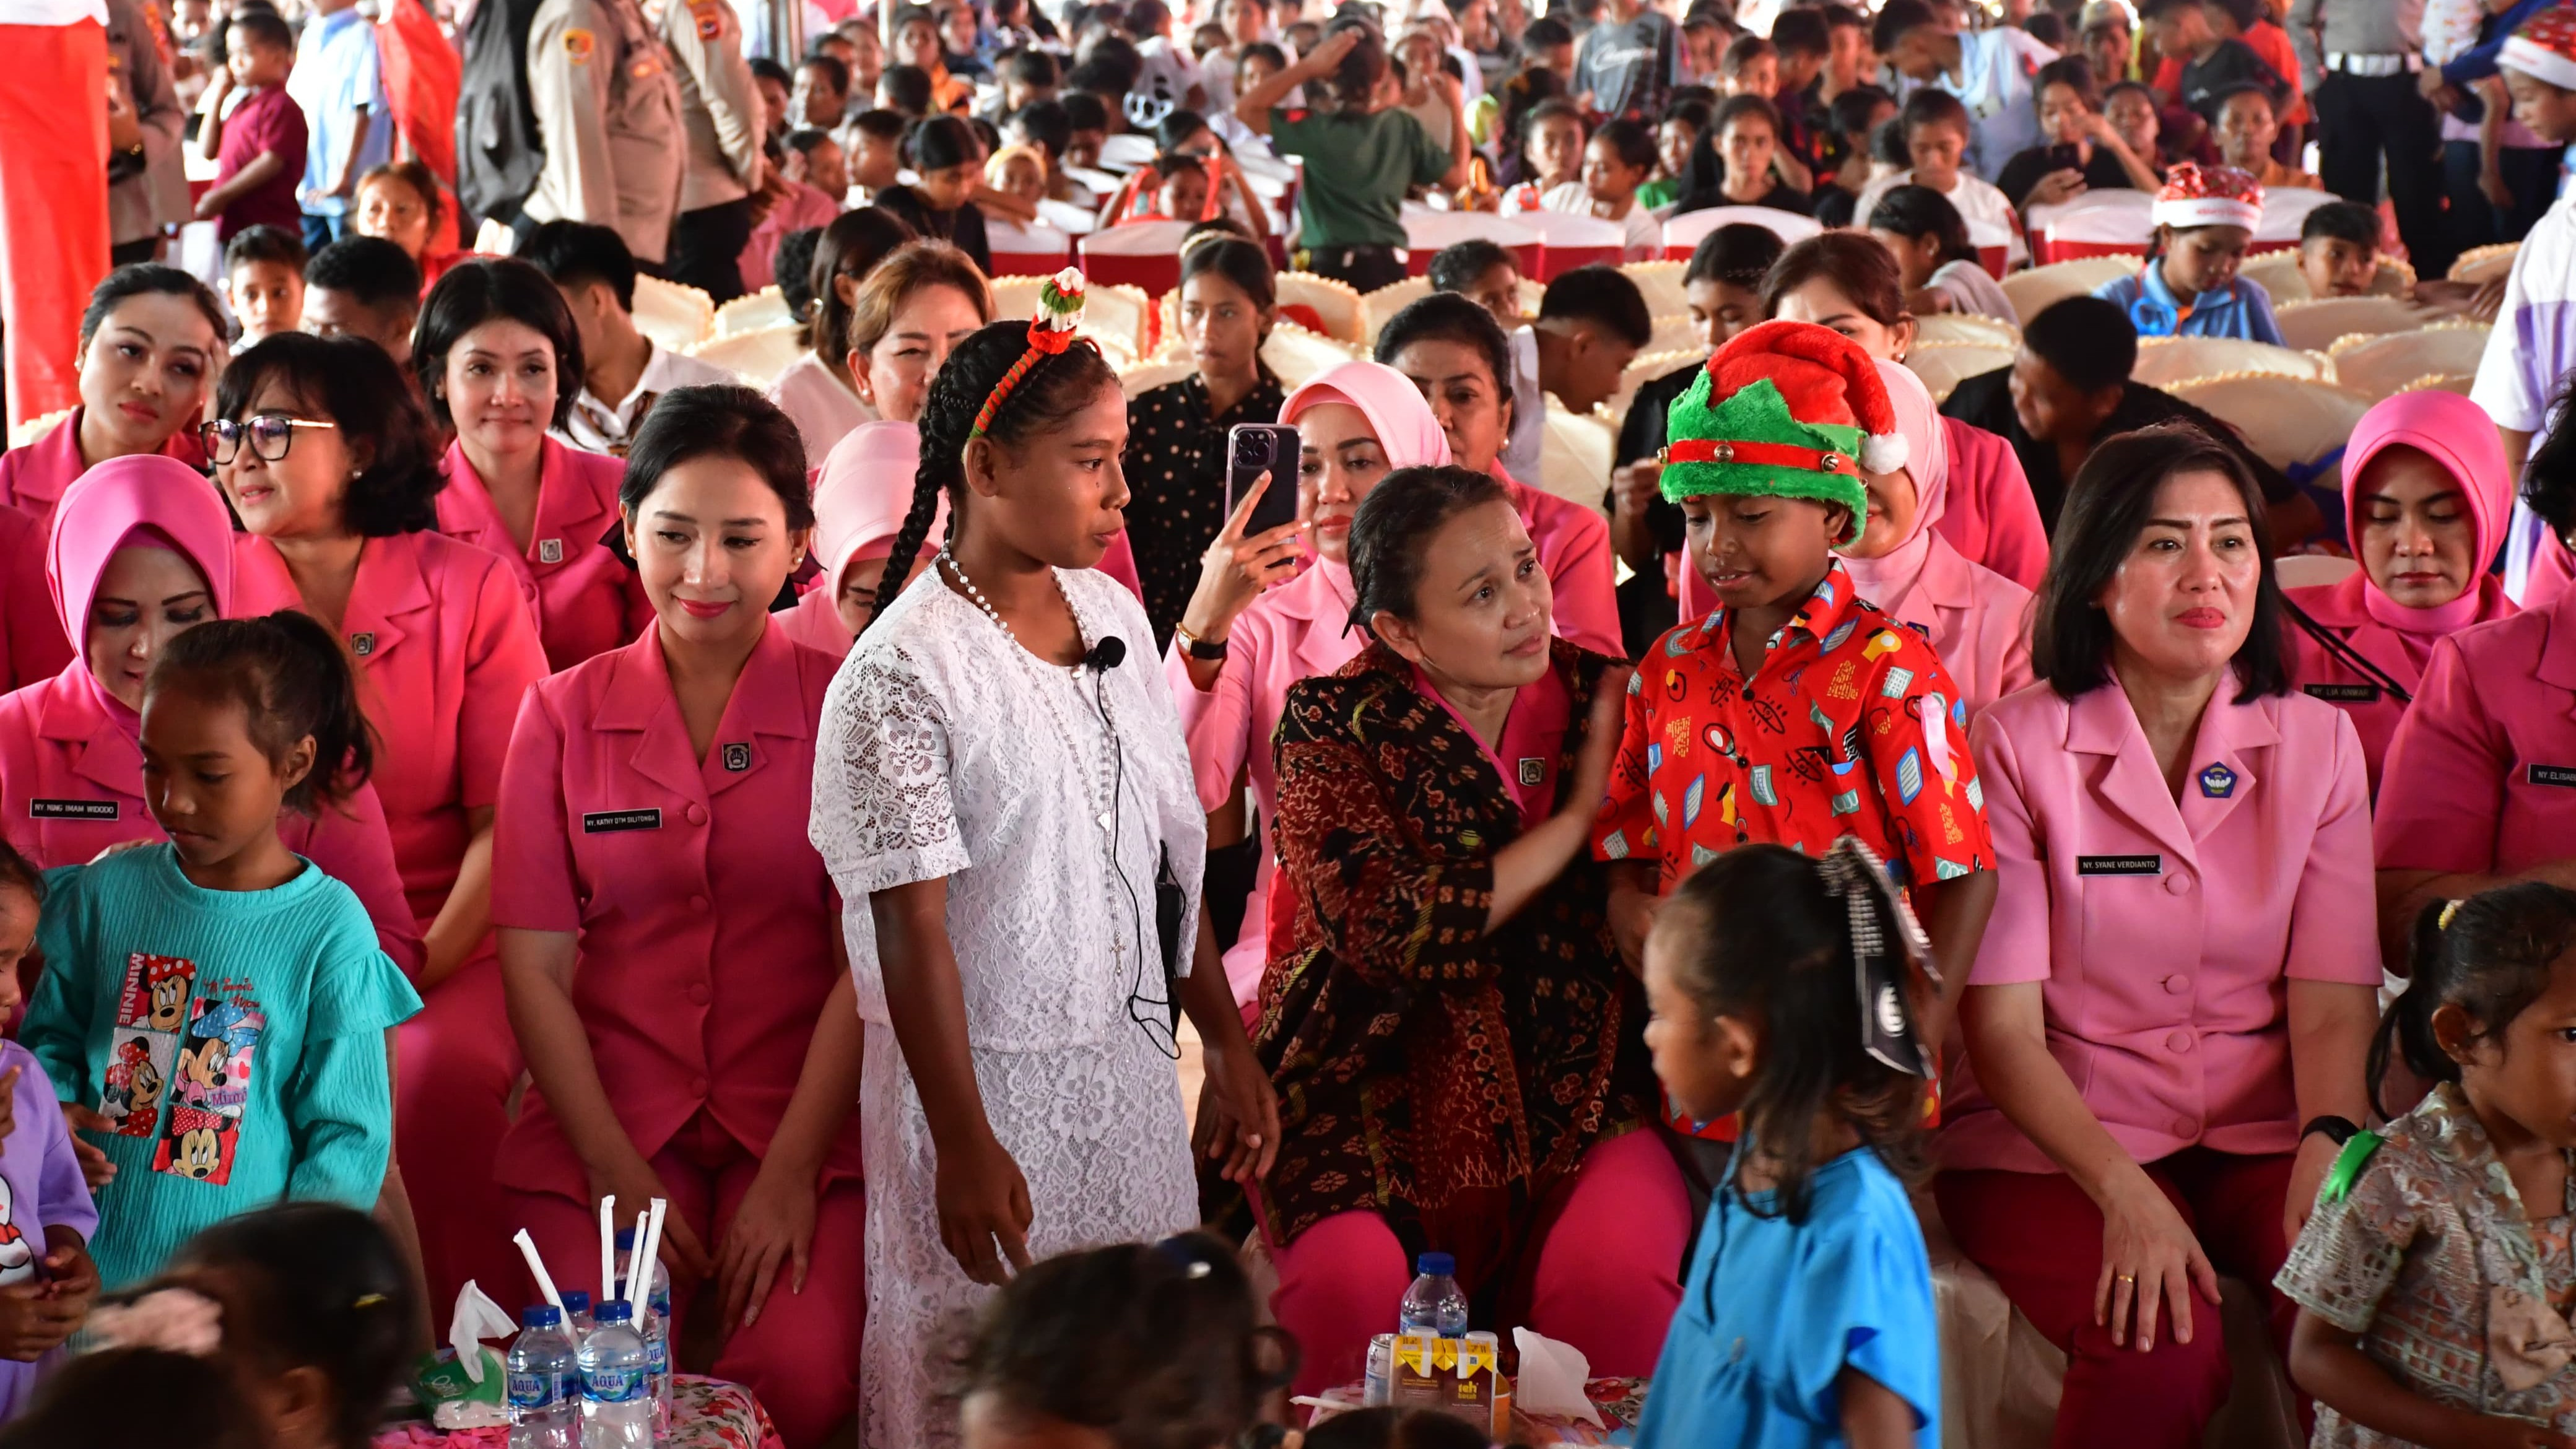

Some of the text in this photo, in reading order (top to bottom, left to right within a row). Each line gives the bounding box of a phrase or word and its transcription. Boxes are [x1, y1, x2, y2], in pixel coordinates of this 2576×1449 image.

[87, 806, 114, 814] WIDODO
[118, 953, 146, 1024] MINNIE
[648, 1347, 664, 1362] QUA
[512, 1380, 540, 1393] AQUA
[592, 1375, 624, 1389] AQUA
[1458, 1381, 1477, 1393] teh
